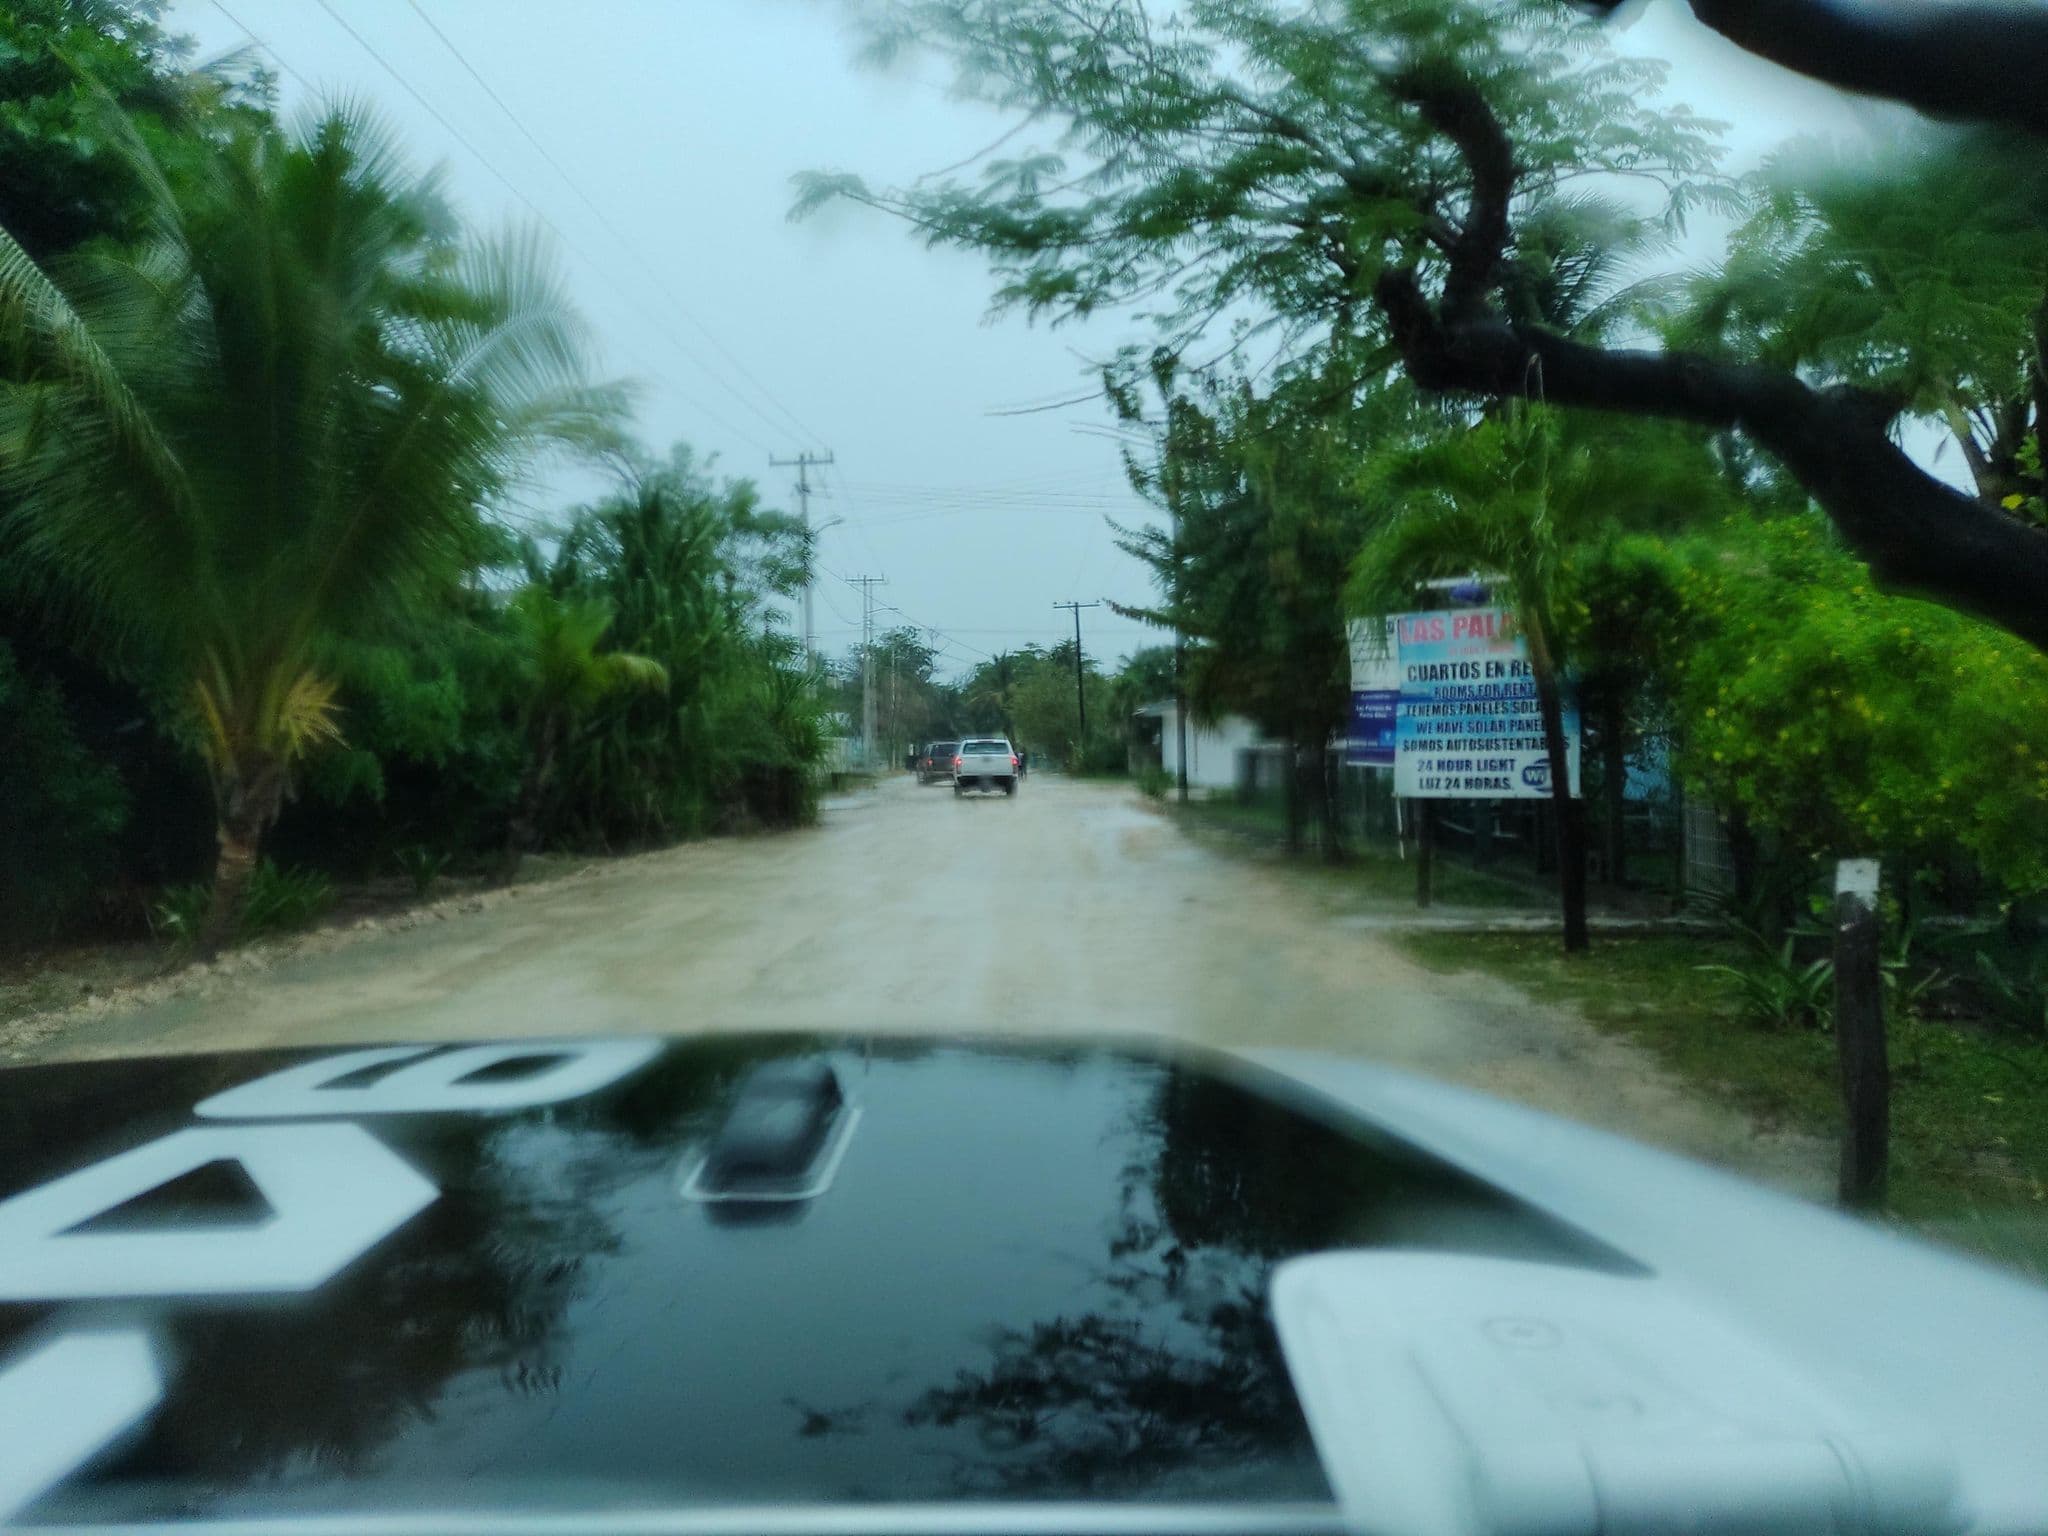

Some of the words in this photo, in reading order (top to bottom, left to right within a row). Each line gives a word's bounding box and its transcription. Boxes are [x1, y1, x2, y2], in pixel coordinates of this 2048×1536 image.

[1400, 618, 1445, 644] LAS
[1407, 661, 1481, 682] CUARTOS
[1486, 660, 1505, 678] EN
[1434, 684, 1474, 699] ROOMS
[1478, 683, 1500, 698] FOR
[1504, 682, 1536, 697] RENT
[1406, 703, 1456, 717] TENEMOS
[1460, 702, 1509, 715] PANELES
[1417, 721, 1433, 734] WE
[1437, 720, 1463, 733] HAVE
[1467, 720, 1506, 733] SOLAR
[1403, 739, 1443, 752] SOMOS
[1417, 759, 1433, 772] 24
[1437, 759, 1472, 772] HOUR
[1477, 758, 1516, 772] LIGHT
[1419, 777, 1440, 790] LUZ
[1445, 777, 1460, 790] 24
